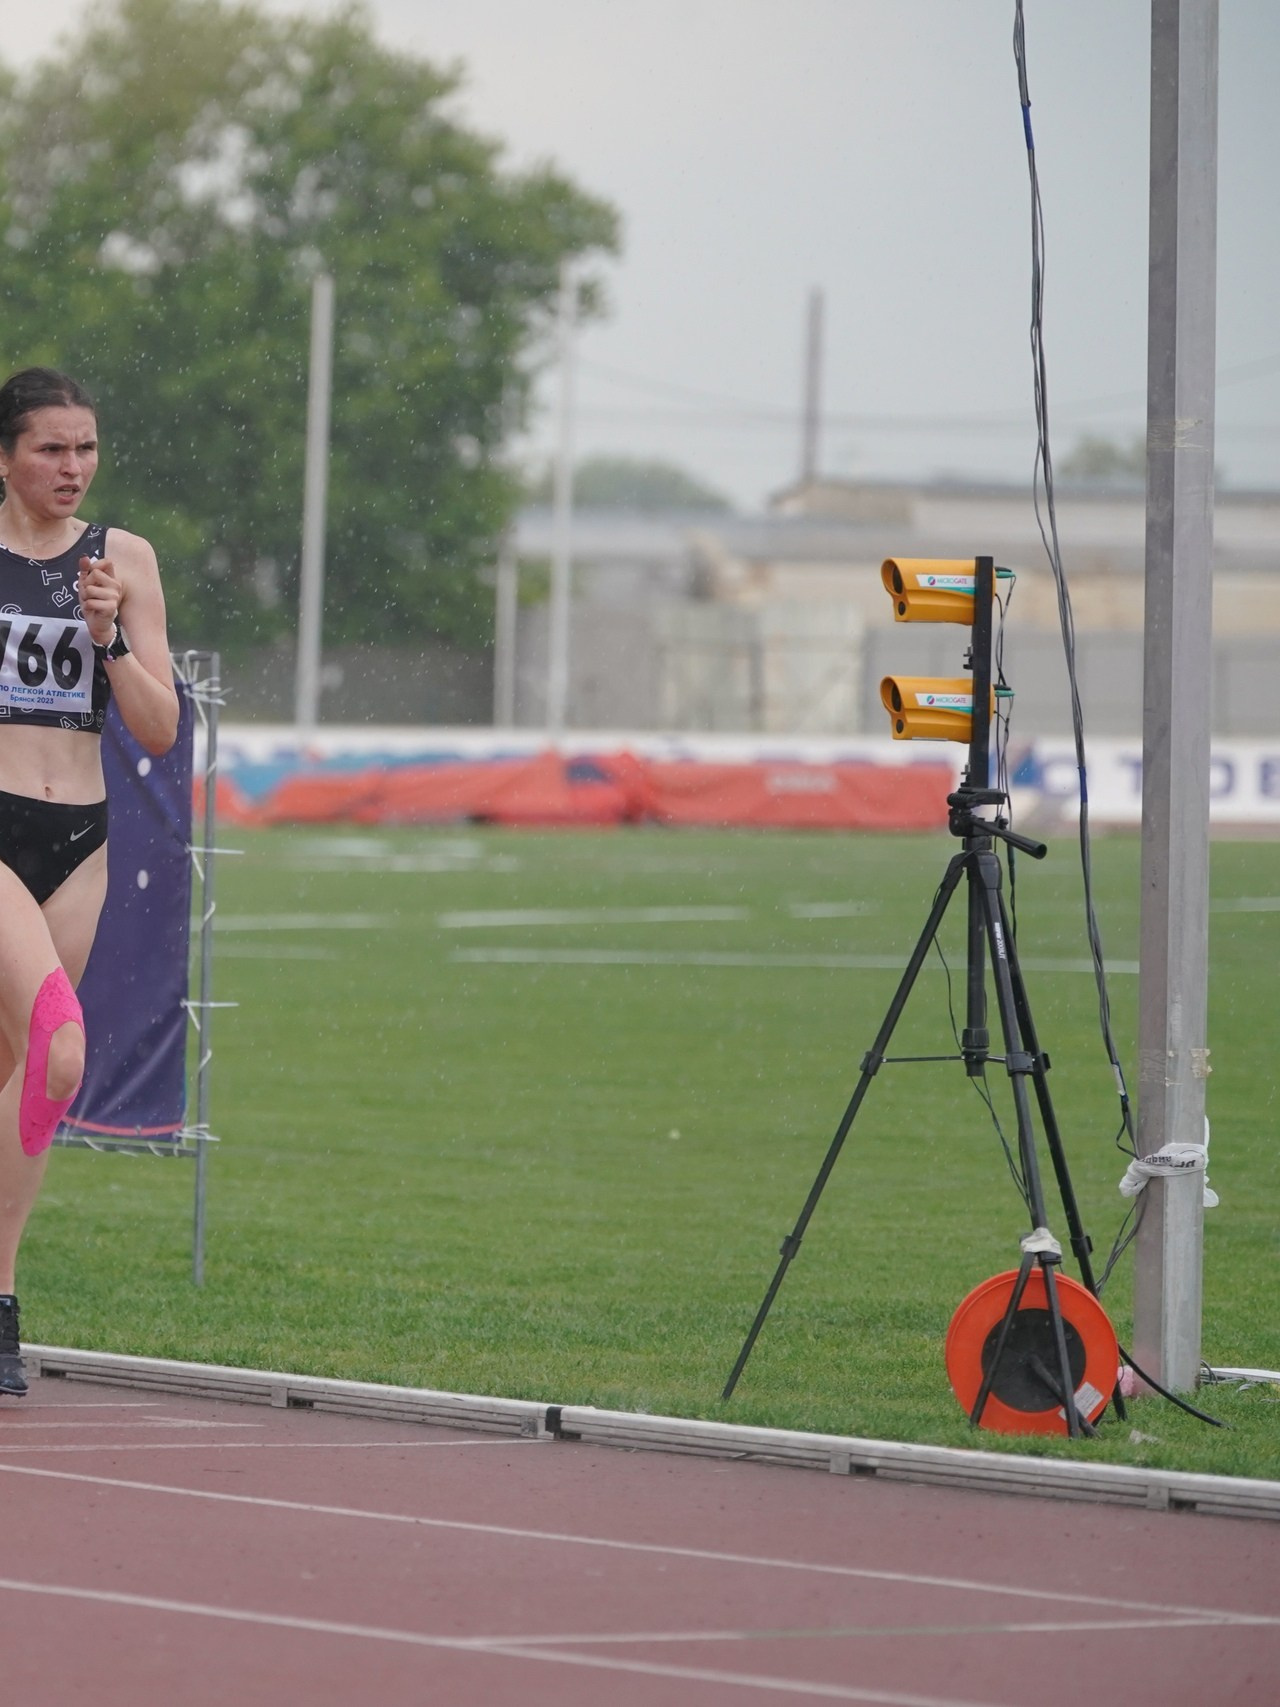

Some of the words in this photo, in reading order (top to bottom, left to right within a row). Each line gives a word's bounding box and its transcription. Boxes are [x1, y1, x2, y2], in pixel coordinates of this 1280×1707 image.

[11, 686, 44, 696] ЛЕГКОЙ
[46, 690, 86, 699] АТЛЕТИКЕ
[10, 694, 35, 703] Брянск
[36, 697, 54, 705] 2023
